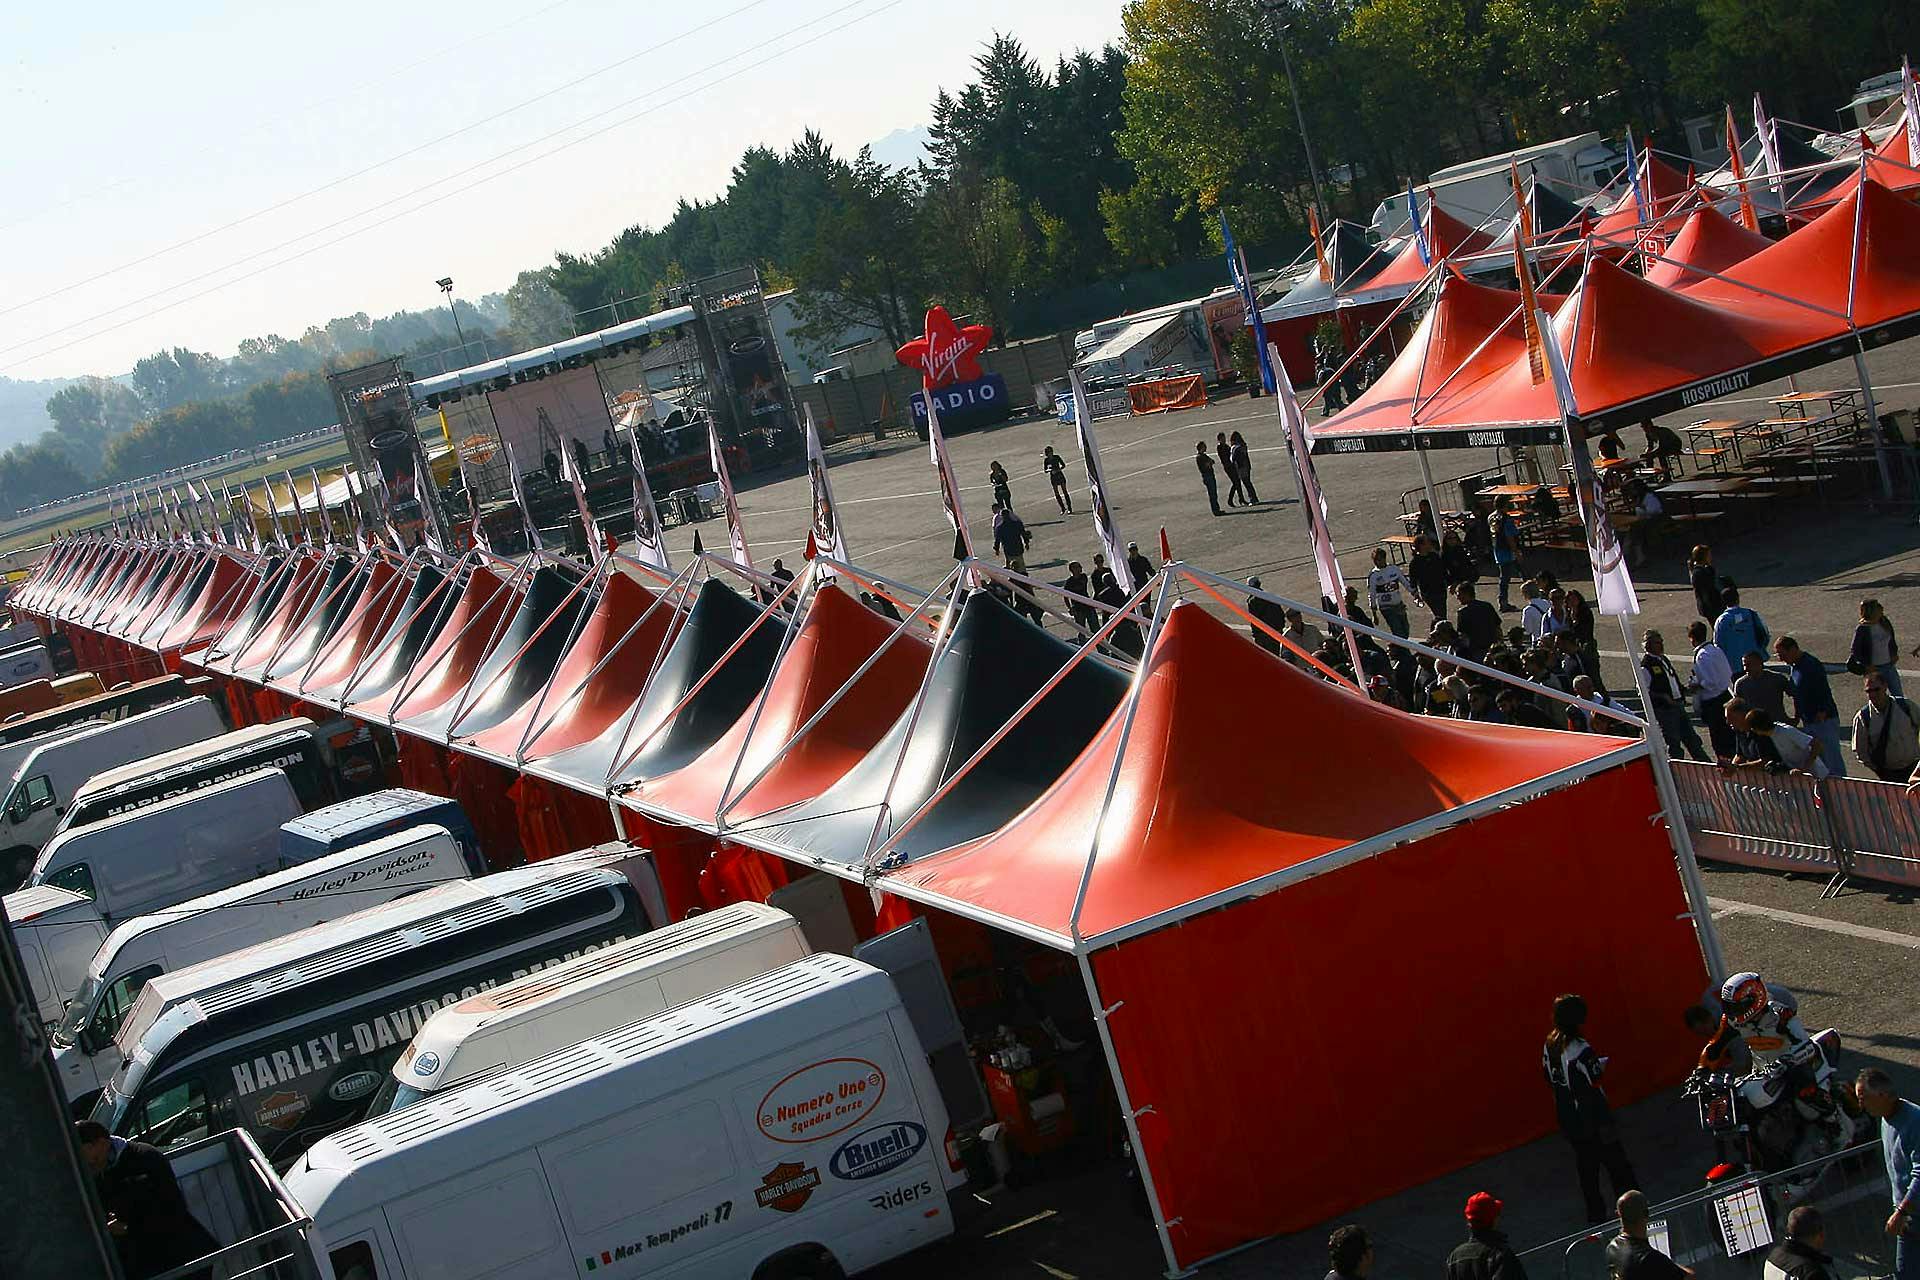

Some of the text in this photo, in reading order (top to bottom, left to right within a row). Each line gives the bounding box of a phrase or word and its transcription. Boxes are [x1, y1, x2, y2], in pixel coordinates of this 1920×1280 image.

[921, 332, 974, 381] Virgin
[913, 385, 995, 416] RADIO
[1681, 371, 1751, 406] HOSPITALITY
[1333, 437, 1367, 452] HOSPITALITY
[1467, 431, 1506, 446] HOSPITALITY
[336, 1073, 373, 1096] Buell
[776, 1079, 866, 1122] Numero Uno
[790, 1099, 863, 1134] Squadra Corse
[843, 1125, 912, 1171] Buell
[759, 1172, 817, 1202] HARLEY-DAVIDSON
[868, 1180, 932, 1211] Riders
[614, 1242, 643, 1262] Max
[645, 1212, 709, 1249] Temporali
